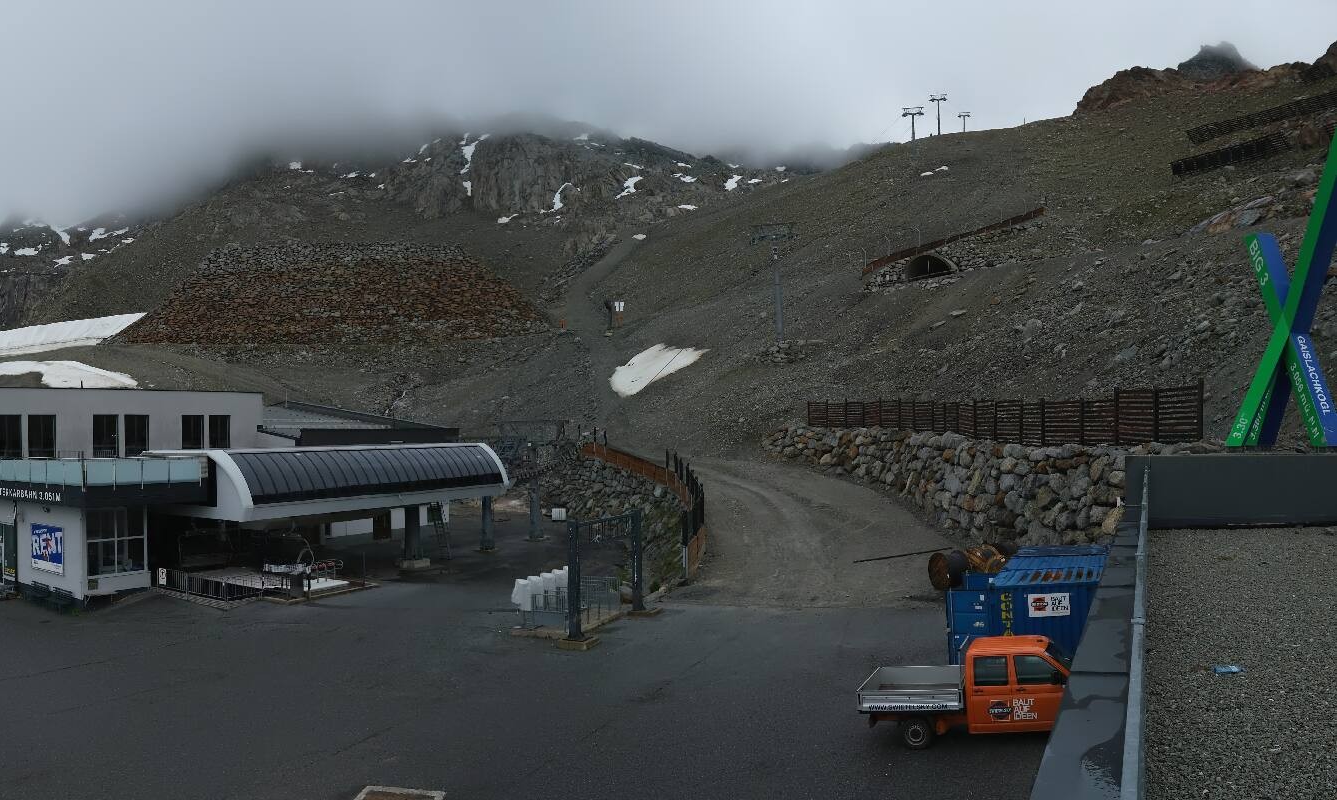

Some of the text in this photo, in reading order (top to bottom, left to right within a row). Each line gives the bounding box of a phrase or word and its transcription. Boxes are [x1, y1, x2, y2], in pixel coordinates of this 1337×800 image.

[1249, 238, 1269, 286] BIG 3
[1297, 335, 1331, 415] GAISLACHKOGL
[31, 531, 63, 556] RENT
[1013, 698, 1034, 707] BAUT
[1014, 712, 1038, 720] IDEEN
